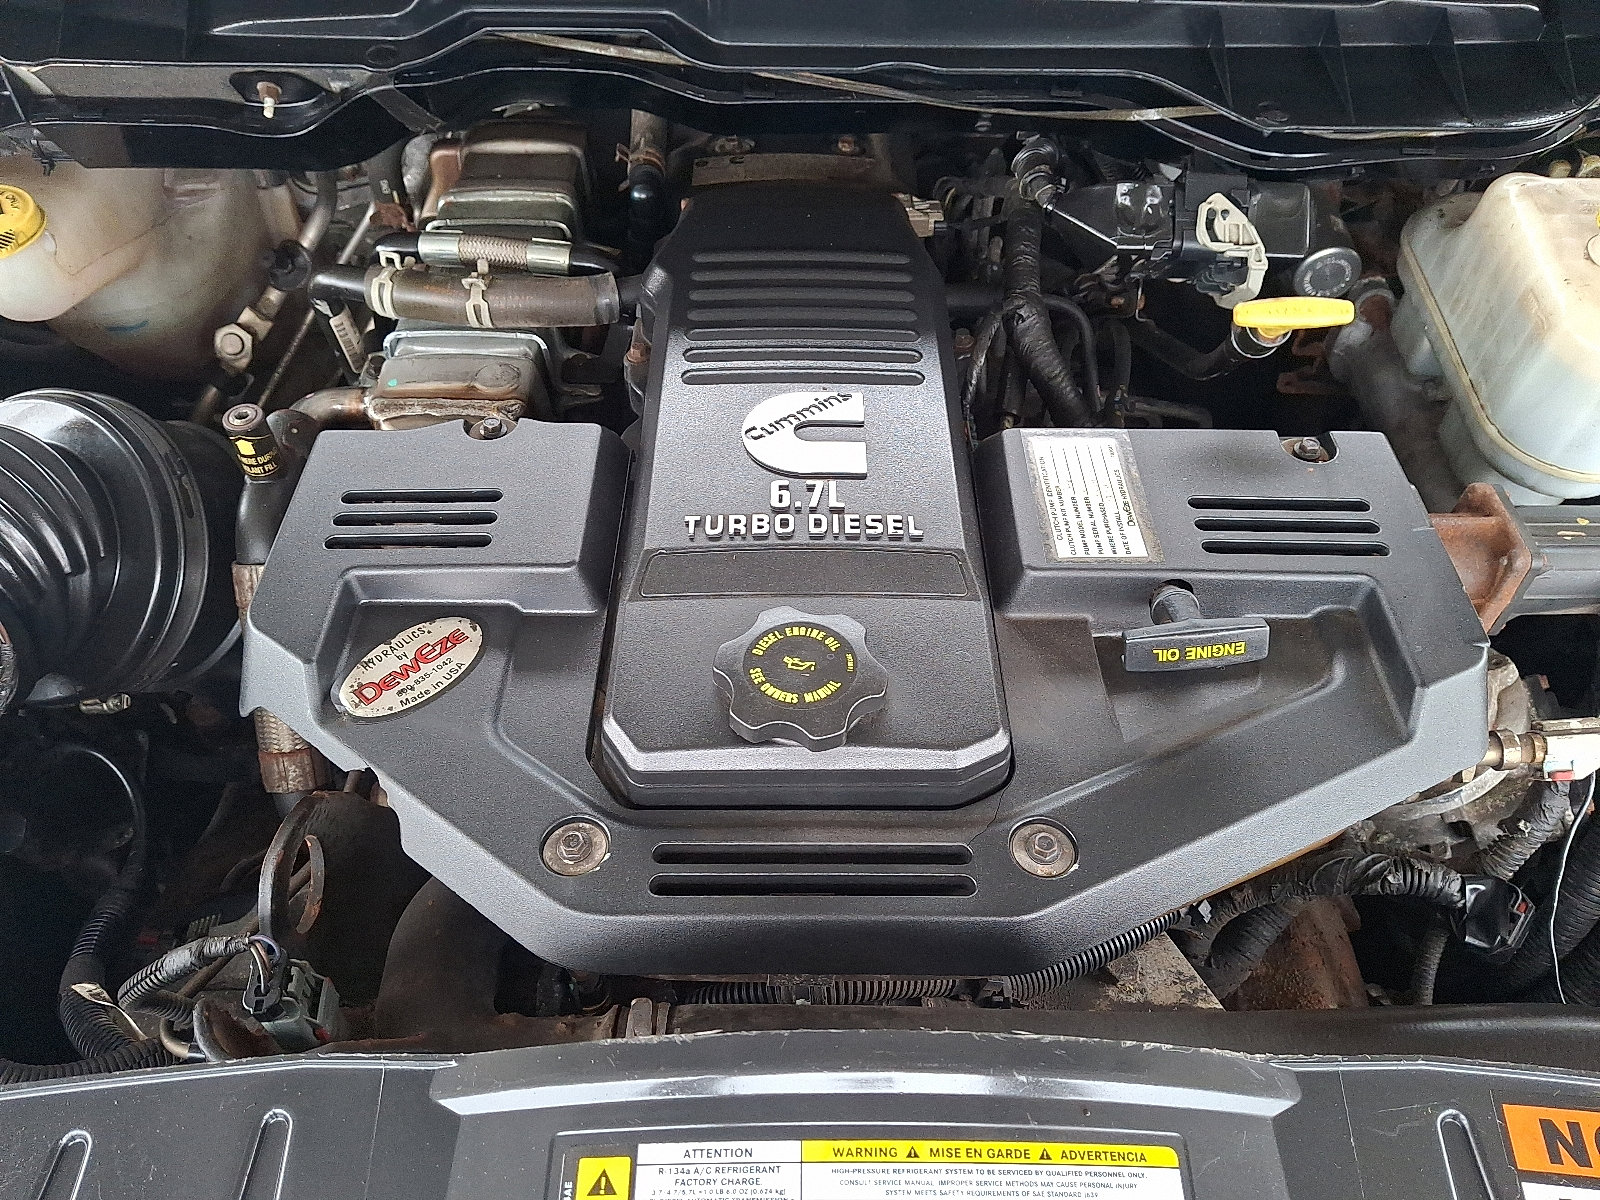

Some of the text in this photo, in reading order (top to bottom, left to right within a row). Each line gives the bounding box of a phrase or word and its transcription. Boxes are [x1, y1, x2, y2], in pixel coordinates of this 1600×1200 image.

[744, 392, 853, 440] Cummins
[770, 480, 846, 511] 6.7L
[684, 513, 924, 540] TURBO DIESEL
[1052, 516, 1063, 541] CLUTCH
[361, 626, 426, 671] HYDRAULICS
[751, 626, 842, 657] DIESEL ENGINE OIL
[1152, 641, 1246, 663] ENGINE OIL
[394, 651, 409, 661] by
[400, 662, 465, 708] Made in USA
[749, 667, 843, 704] SEE OWNERS MANUAL
[683, 1148, 753, 1160] ATTENTION
[832, 1147, 1148, 1163] WARNING MISE EN GARDE ADVERTENCIA
[1538, 1118, 1600, 1169] N
[658, 1165, 782, 1175] R-134a A/C REFRIGERANT
[674, 1178, 718, 1187] FACTORY
[1084, 1170, 1126, 1178] PERSONNEL
[1079, 1181, 1114, 1189] PERSONAL
